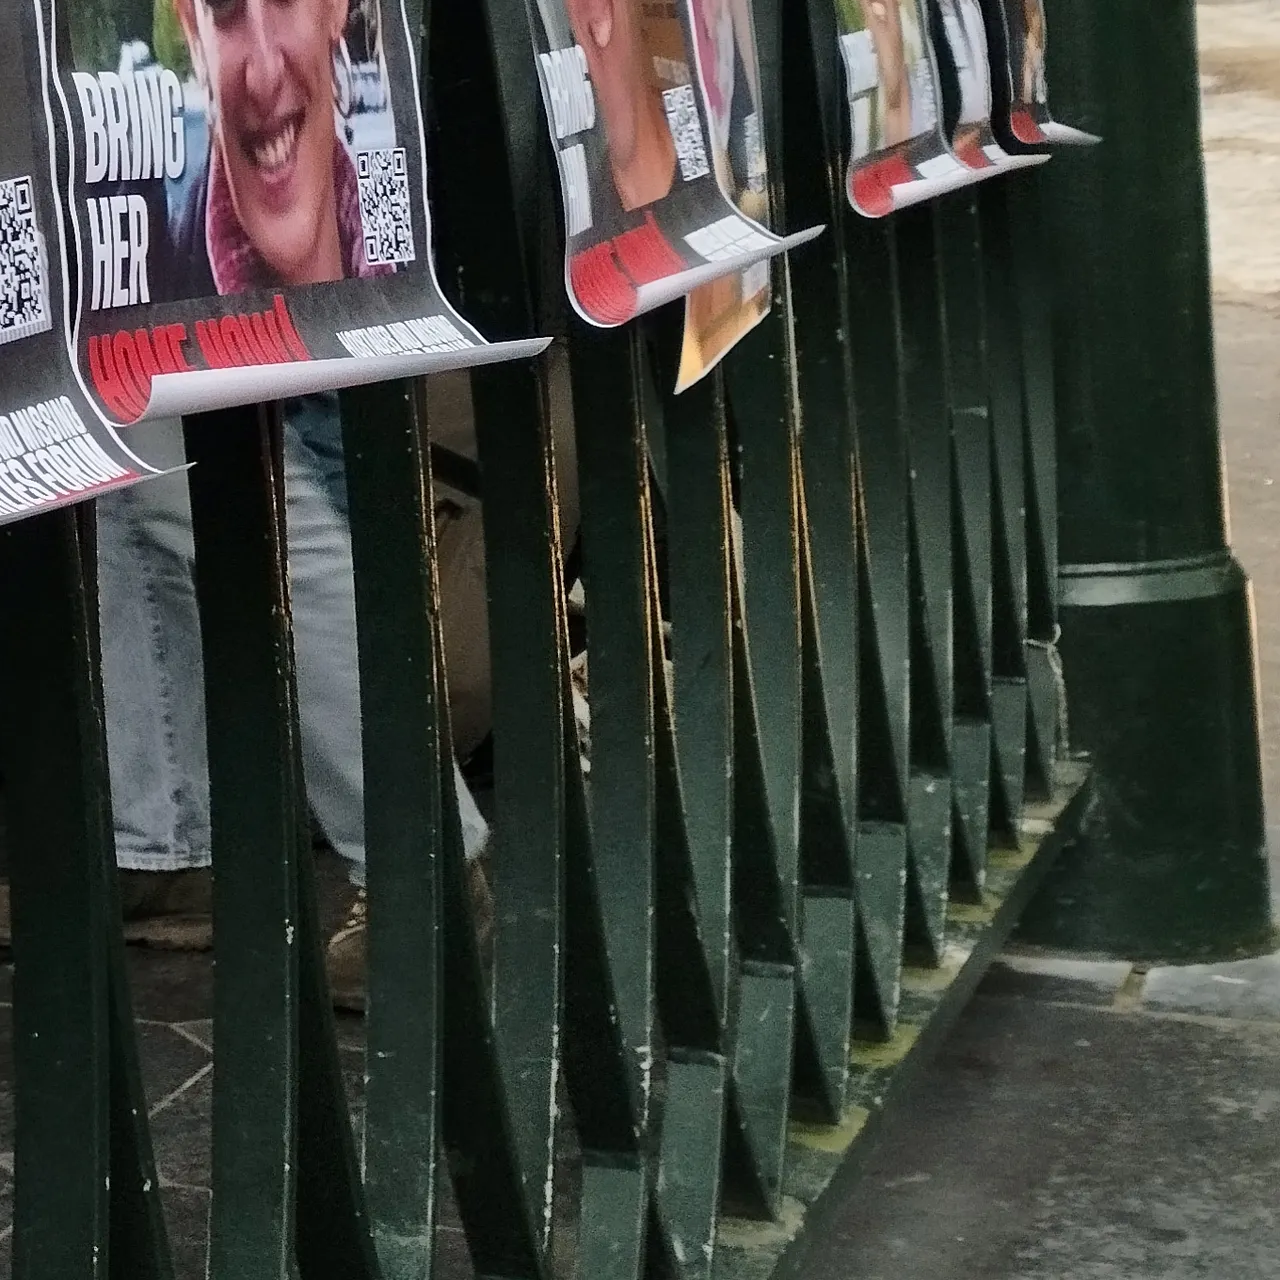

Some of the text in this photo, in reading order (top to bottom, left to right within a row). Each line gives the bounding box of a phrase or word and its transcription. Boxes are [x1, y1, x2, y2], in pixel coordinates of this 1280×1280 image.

[71, 68, 185, 184] BRING
[87, 194, 151, 311] HER
[10, 395, 88, 450] MISSING
[23, 433, 131, 502] FORUM
